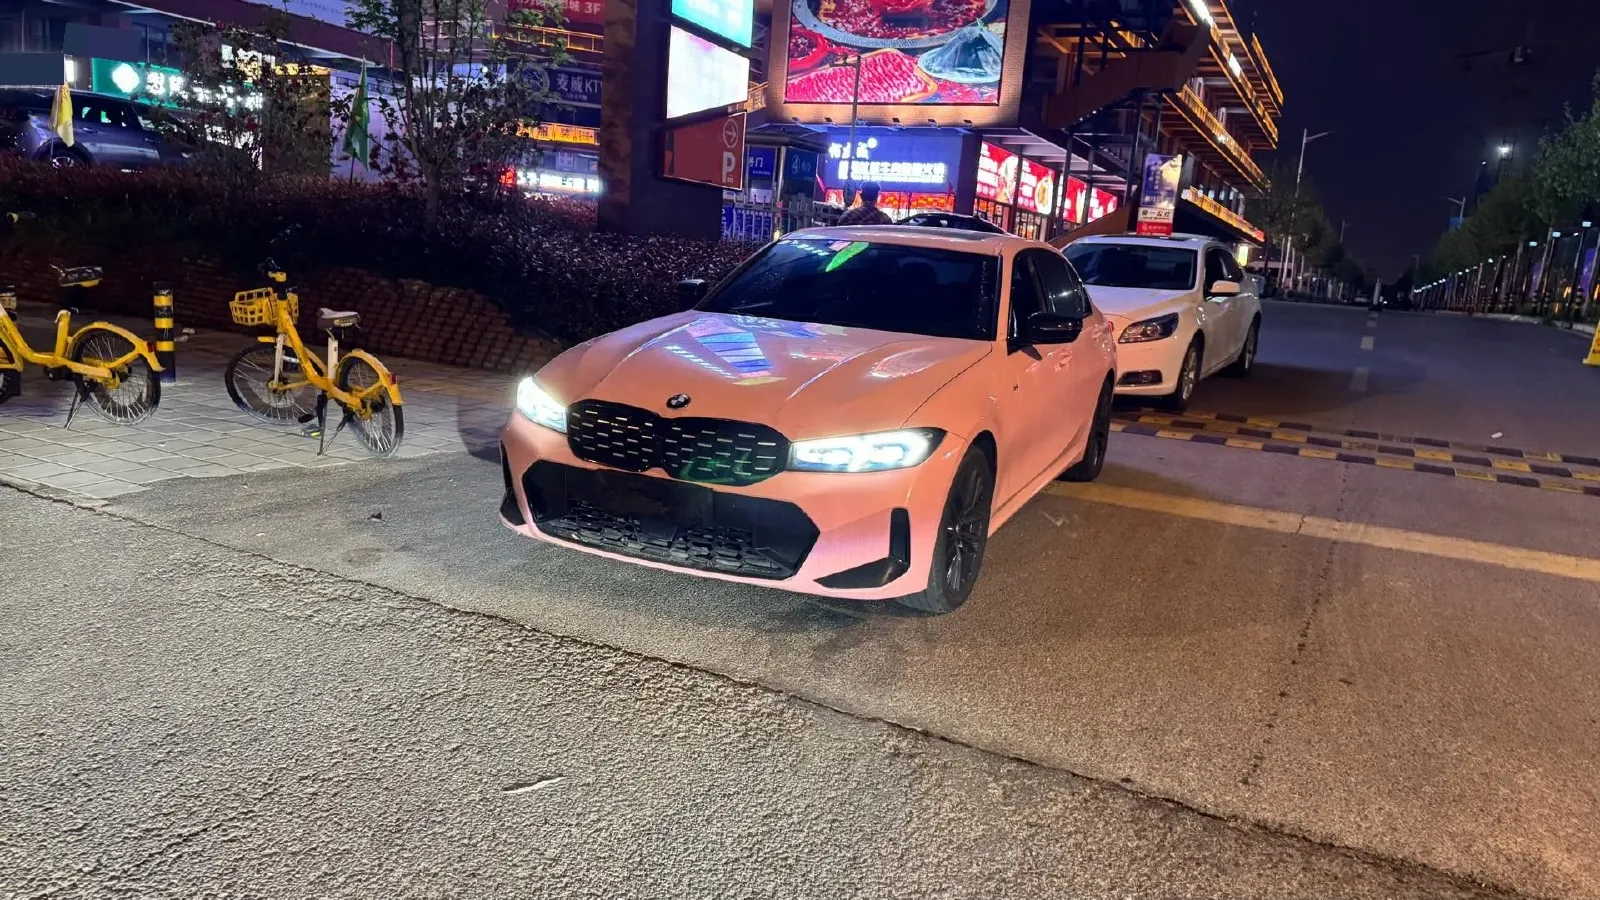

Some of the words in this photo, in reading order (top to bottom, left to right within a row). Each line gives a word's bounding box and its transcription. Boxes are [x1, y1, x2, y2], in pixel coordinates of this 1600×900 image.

[584, 2, 601, 15] 3F
[556, 73, 603, 94] 麦威KT
[722, 151, 736, 183] P
